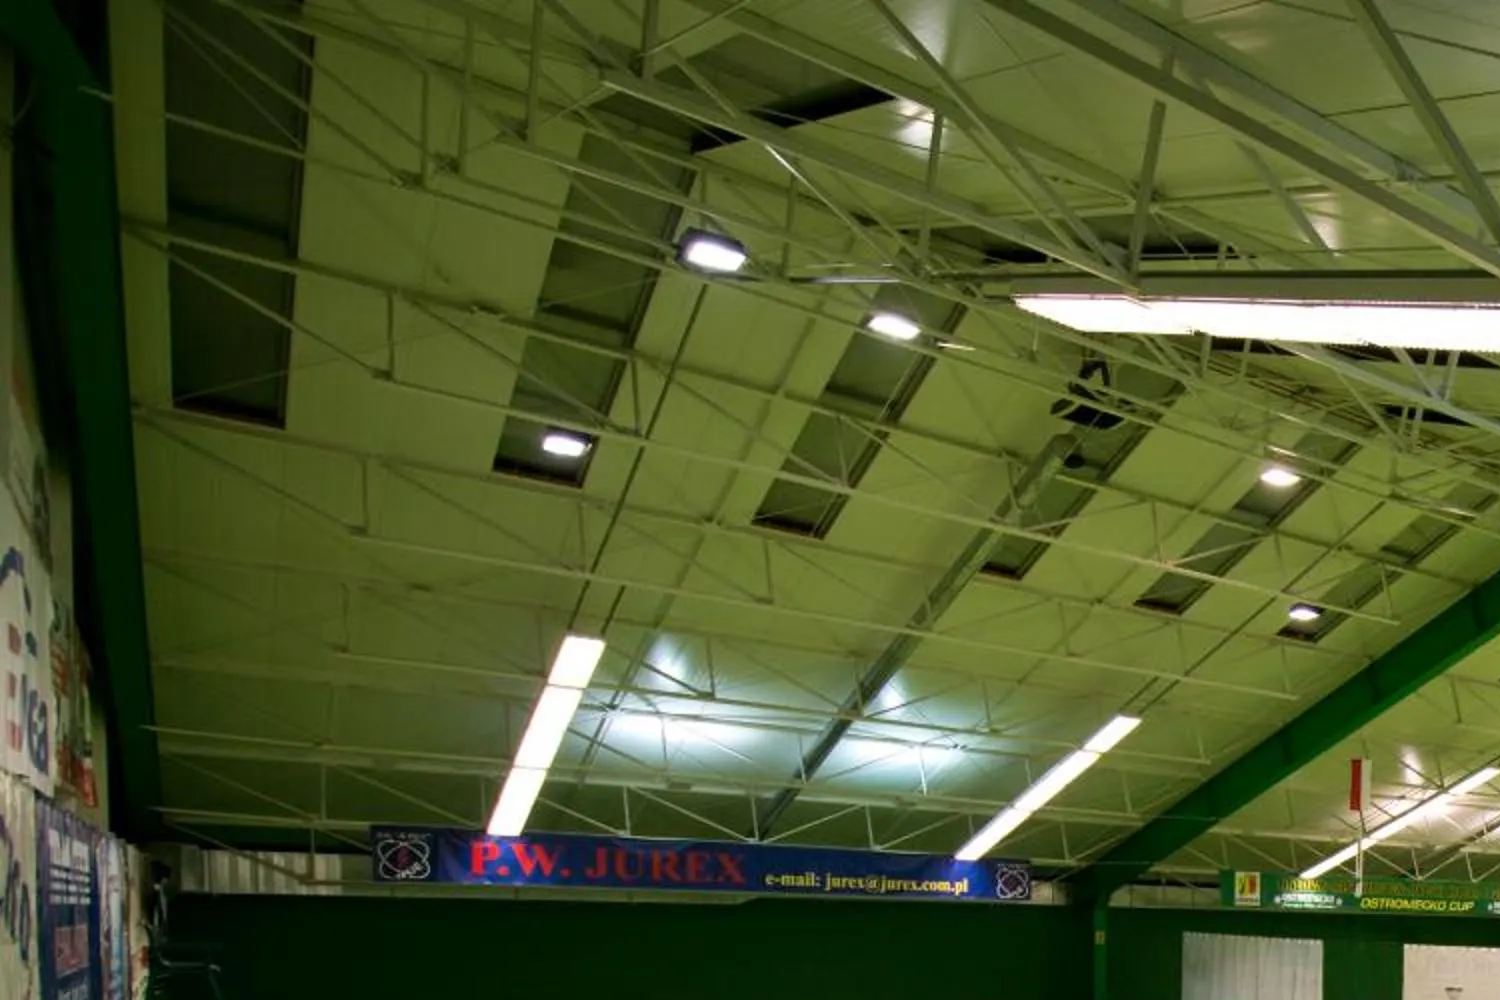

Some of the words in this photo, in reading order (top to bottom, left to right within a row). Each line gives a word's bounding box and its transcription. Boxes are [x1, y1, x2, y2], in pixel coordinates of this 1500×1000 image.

[468, 839, 571, 878] P.W.
[584, 846, 748, 885] JUREX
[764, 872, 821, 888] e-mail:
[825, 872, 970, 896] jurex@jurex.com.pl
[1450, 900, 1475, 912] CUP
